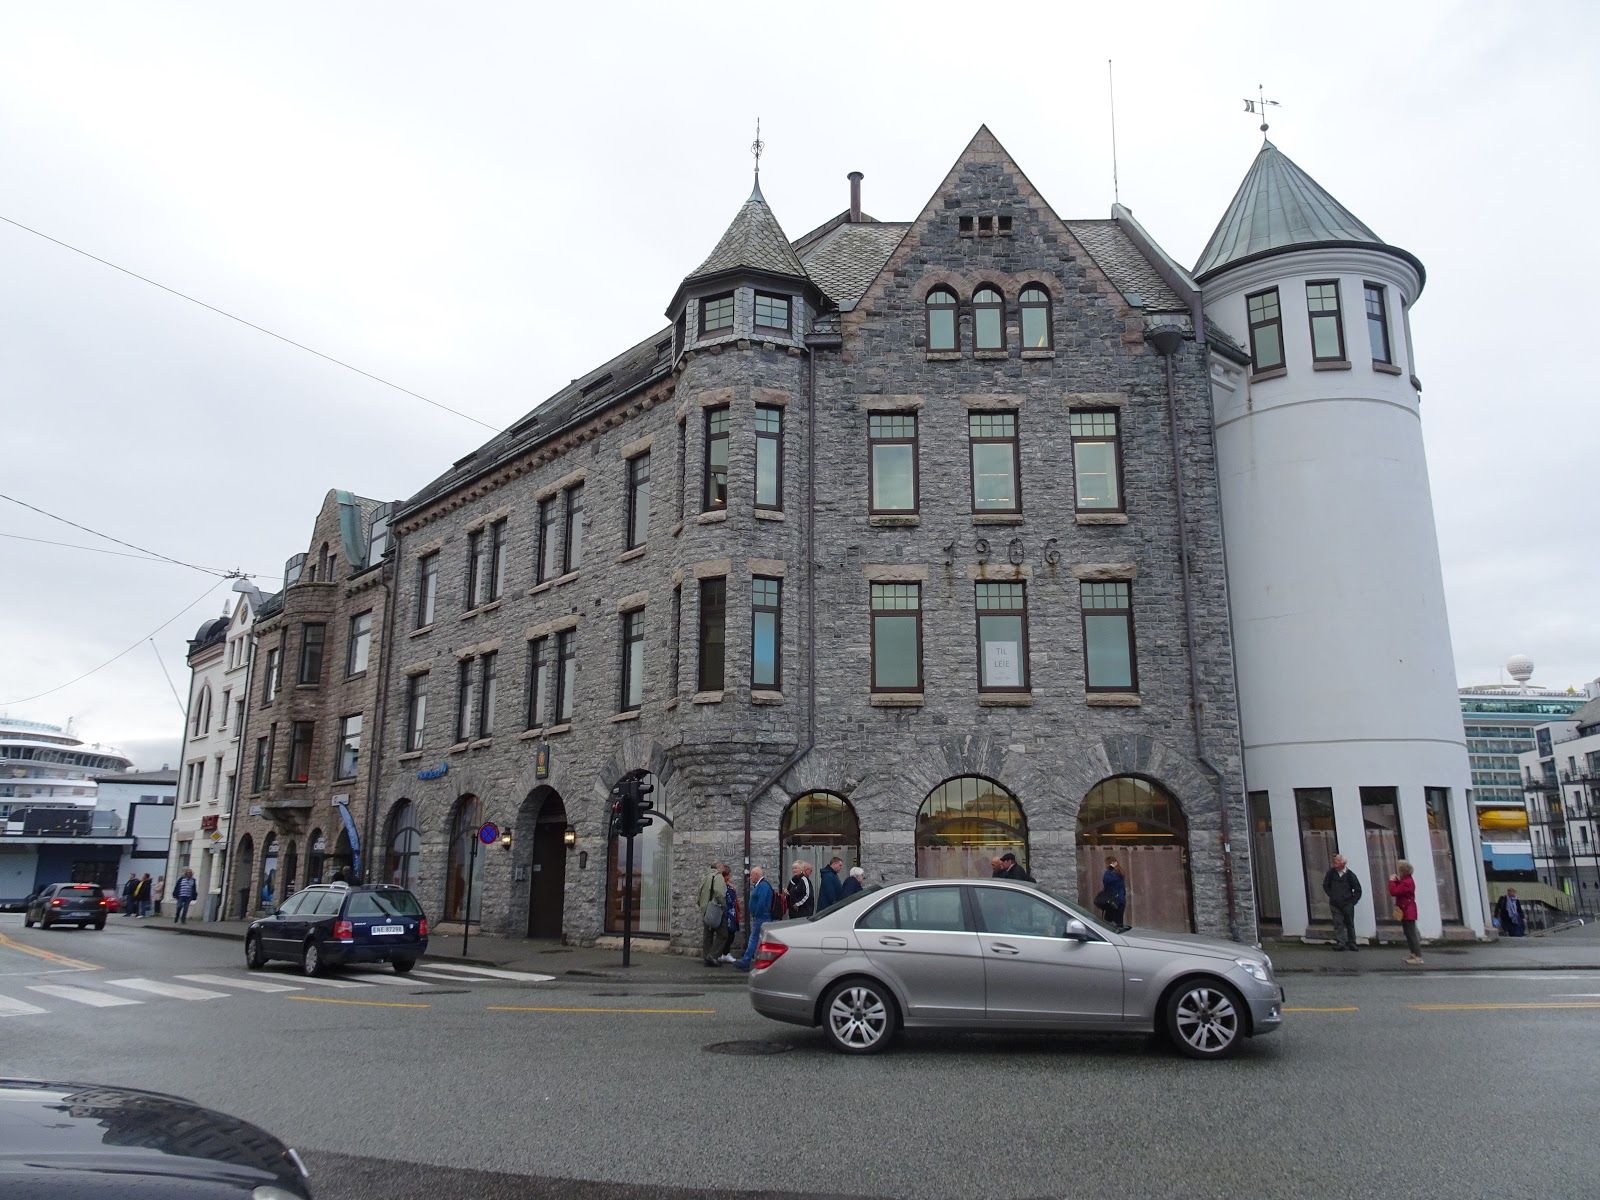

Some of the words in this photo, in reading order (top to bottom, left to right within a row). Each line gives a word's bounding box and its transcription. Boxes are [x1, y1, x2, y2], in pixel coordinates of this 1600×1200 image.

[943, 538, 1061, 566] 1906
[995, 647, 1007, 656] TIL
[994, 660, 1010, 668] LEIE
